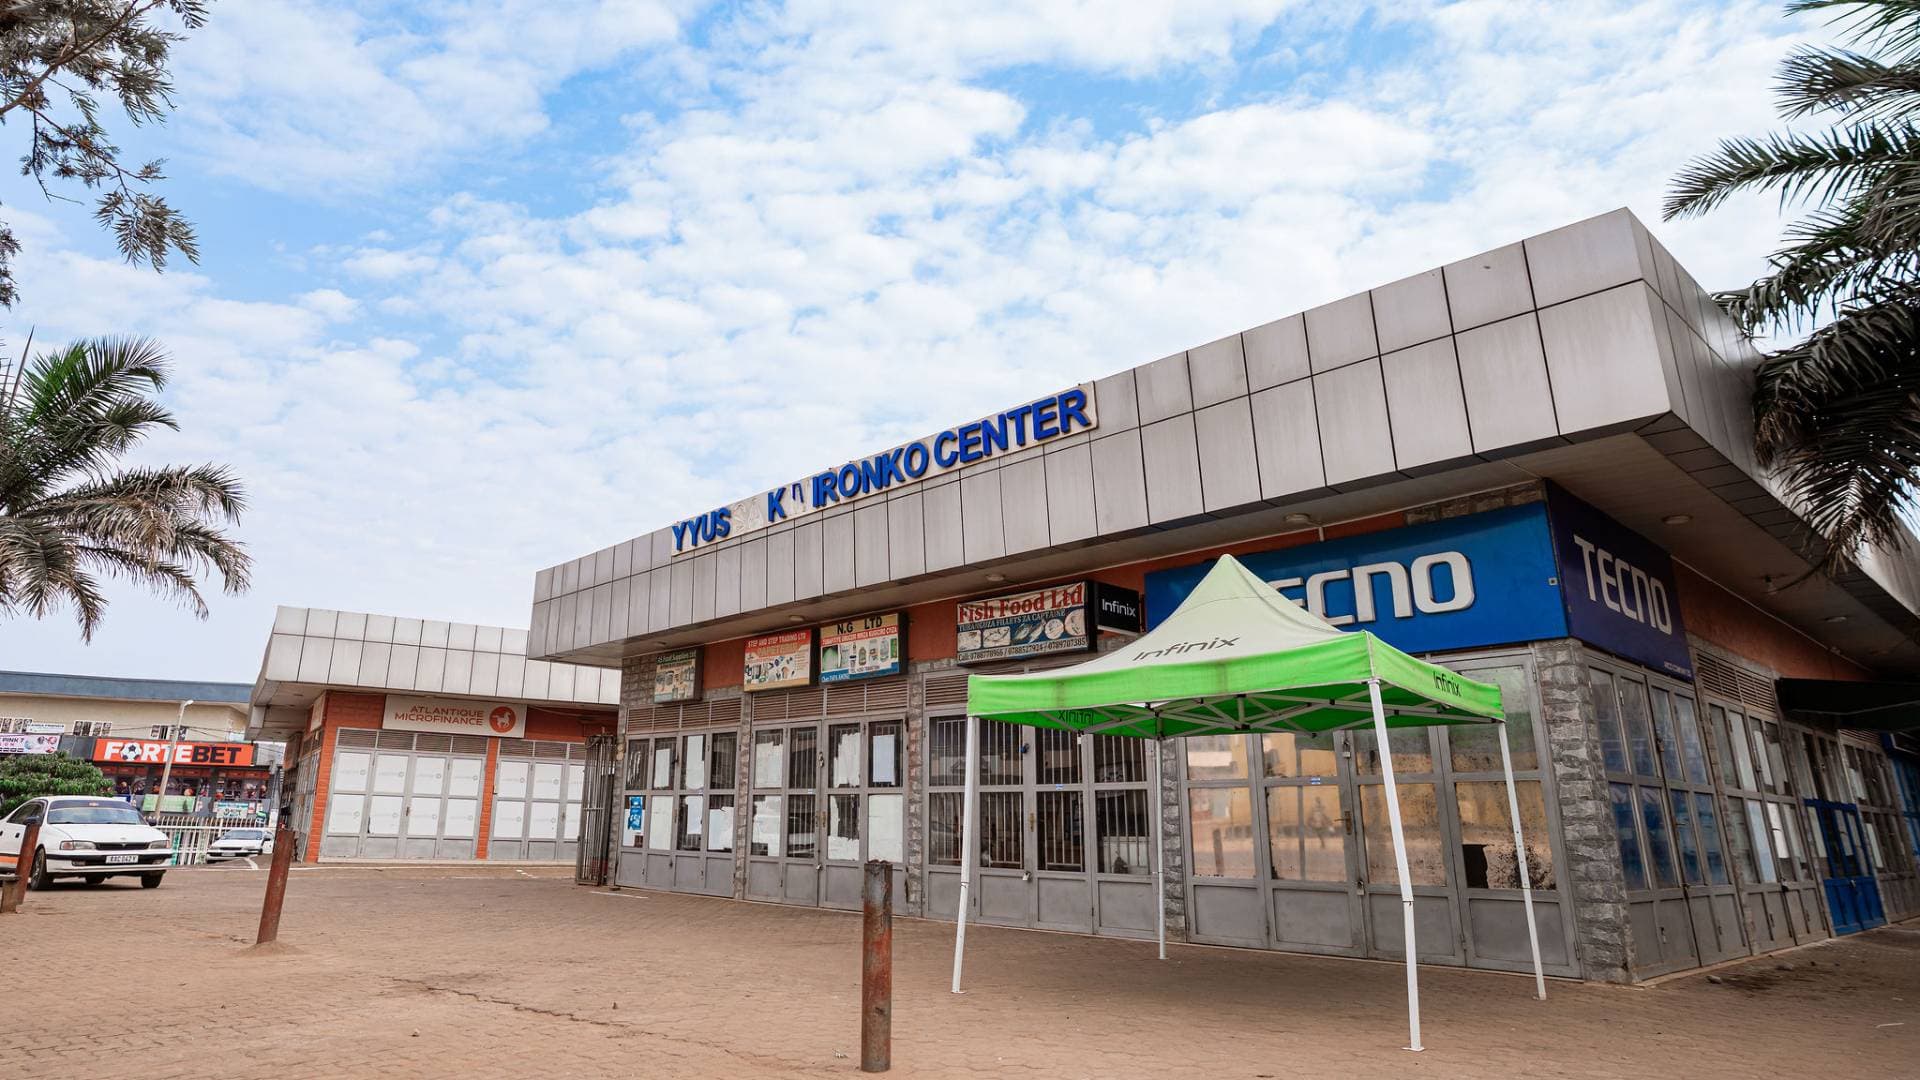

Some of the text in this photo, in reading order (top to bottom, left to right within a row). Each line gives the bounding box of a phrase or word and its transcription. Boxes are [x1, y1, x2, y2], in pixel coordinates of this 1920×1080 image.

[934, 389, 1092, 468] CENTER
[1573, 534, 1672, 636] TECNO
[959, 584, 1084, 624] Fish Food Ltd
[1101, 599, 1136, 617] Infinix
[837, 616, 882, 635] N.G LTD
[1132, 637, 1240, 661] Infinix
[1432, 671, 1461, 697] Infinix
[395, 712, 483, 726] MICROFINANCE
[410, 705, 484, 718] ATLANTIQUE
